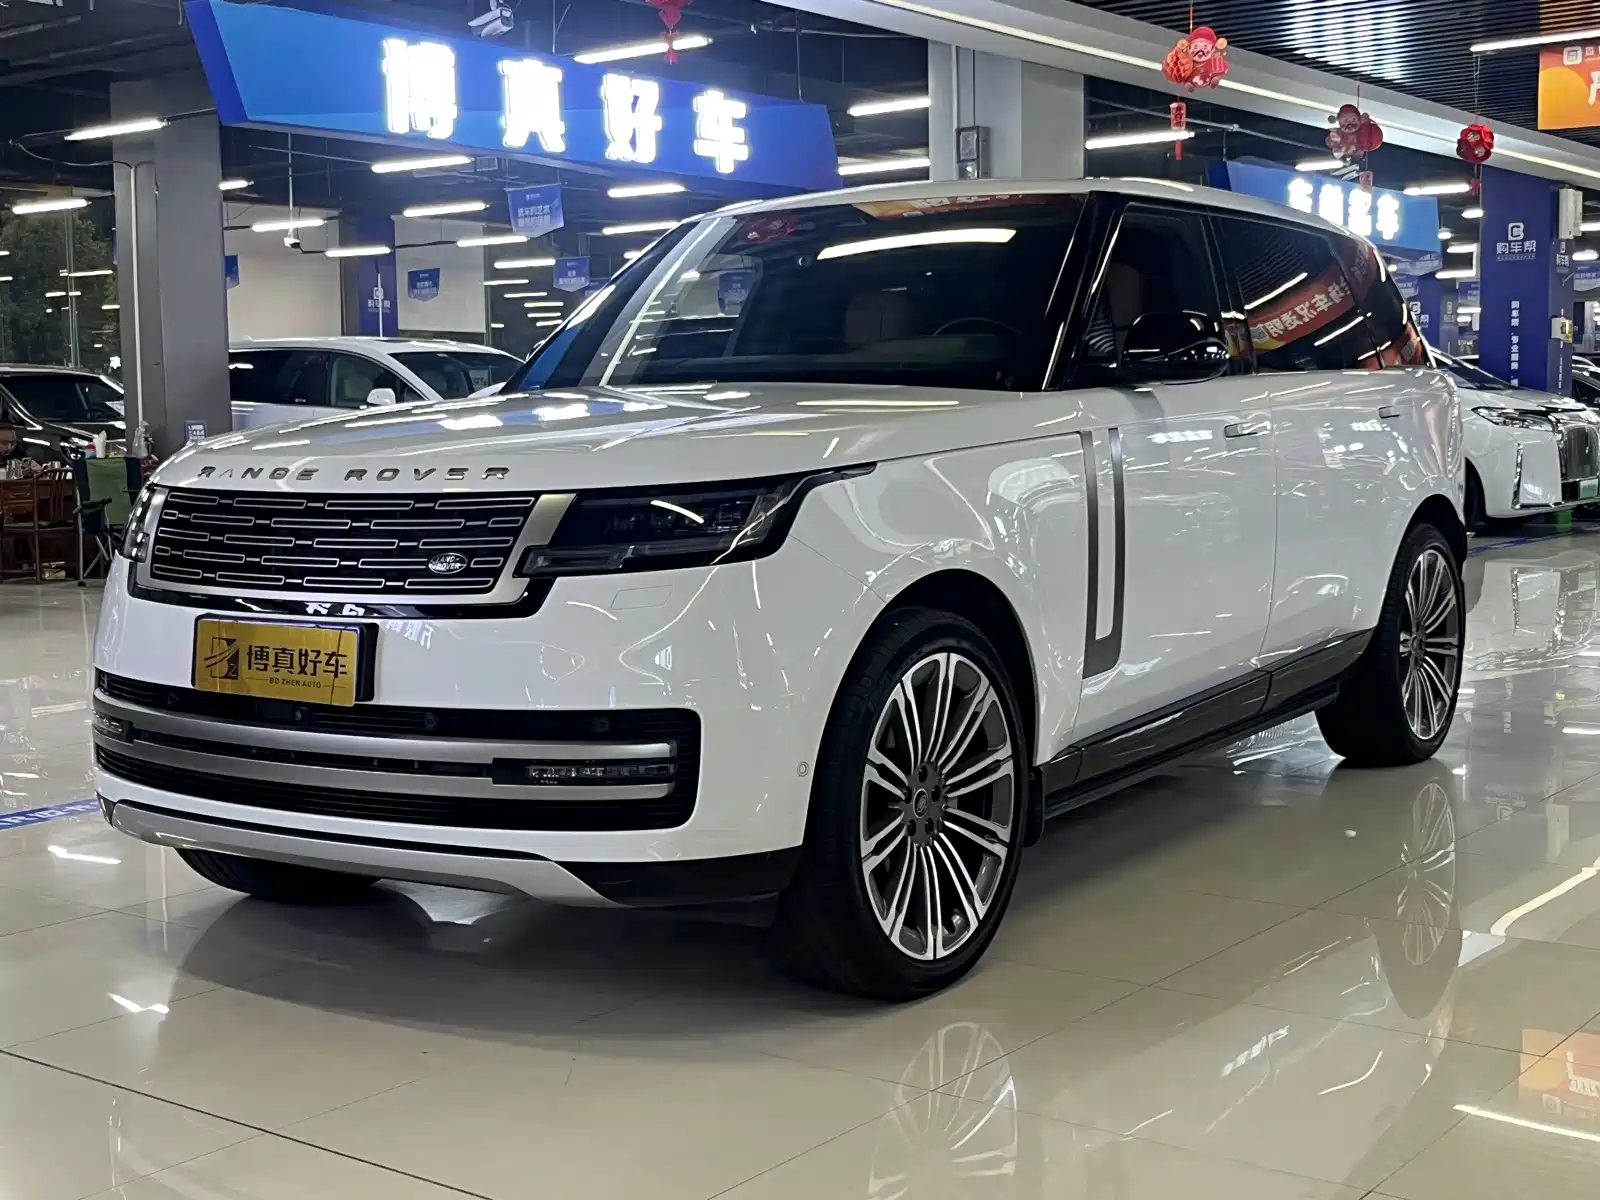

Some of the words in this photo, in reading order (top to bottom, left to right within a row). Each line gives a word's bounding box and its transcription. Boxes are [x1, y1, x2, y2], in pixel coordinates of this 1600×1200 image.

[1496, 240, 1537, 254] 购车帮
[197, 465, 319, 481] RANGE
[344, 467, 510, 481] ROVER
[246, 644, 348, 678] 博真好车
[269, 677, 280, 685] BO
[281, 678, 300, 687] ZHEN
[302, 681, 322, 689] AUTO
